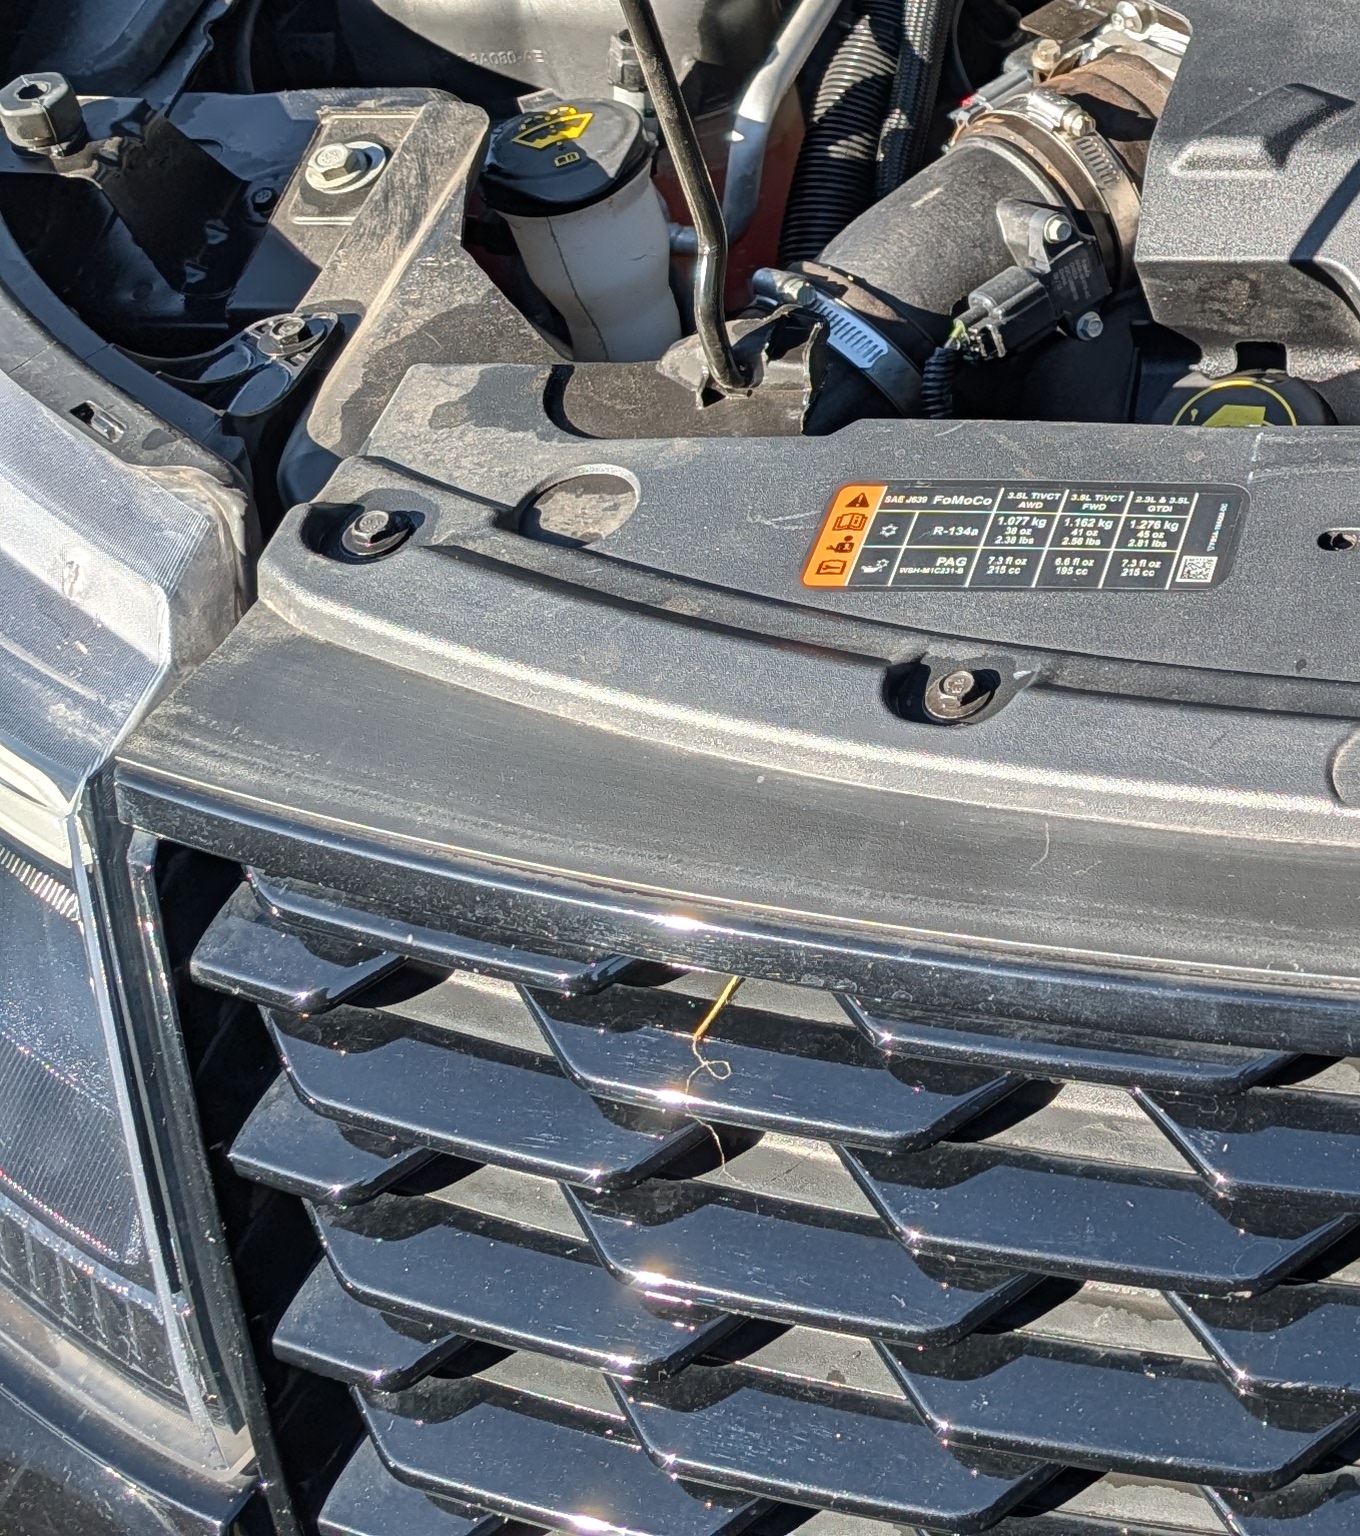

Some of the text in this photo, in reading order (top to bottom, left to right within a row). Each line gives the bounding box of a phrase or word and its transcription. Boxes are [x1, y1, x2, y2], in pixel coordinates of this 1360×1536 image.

[884, 495, 993, 506] SAE J639 FoMoCo
[1018, 501, 1044, 510] AWD
[1134, 496, 1190, 505] 2.3L & 3.5L
[1081, 503, 1107, 511] FWD
[997, 516, 1047, 529] 1.077 kg
[1063, 517, 1114, 531] 1.162 kg
[1129, 519, 1180, 533] 1.276 kg
[933, 526, 979, 536] R-134a
[1004, 526, 1032, 536] 38 oz
[1070, 528, 1083, 536] 41
[1136, 530, 1150, 539] 45
[994, 535, 1035, 545] 2.38 lbs
[1085, 537, 1101, 546] lbs
[1127, 539, 1168, 548] 2.81 lbs
[936, 556, 968, 567] PAG
[987, 556, 1004, 565] 7.3
[1054, 557, 1071, 567] 6.6
[1121, 559, 1138, 568] 7.3
[1148, 561, 1162, 569] oz
[986, 565, 1021, 575] 215 cc
[1056, 567, 1075, 575] 195
[1120, 568, 1141, 577] 215
